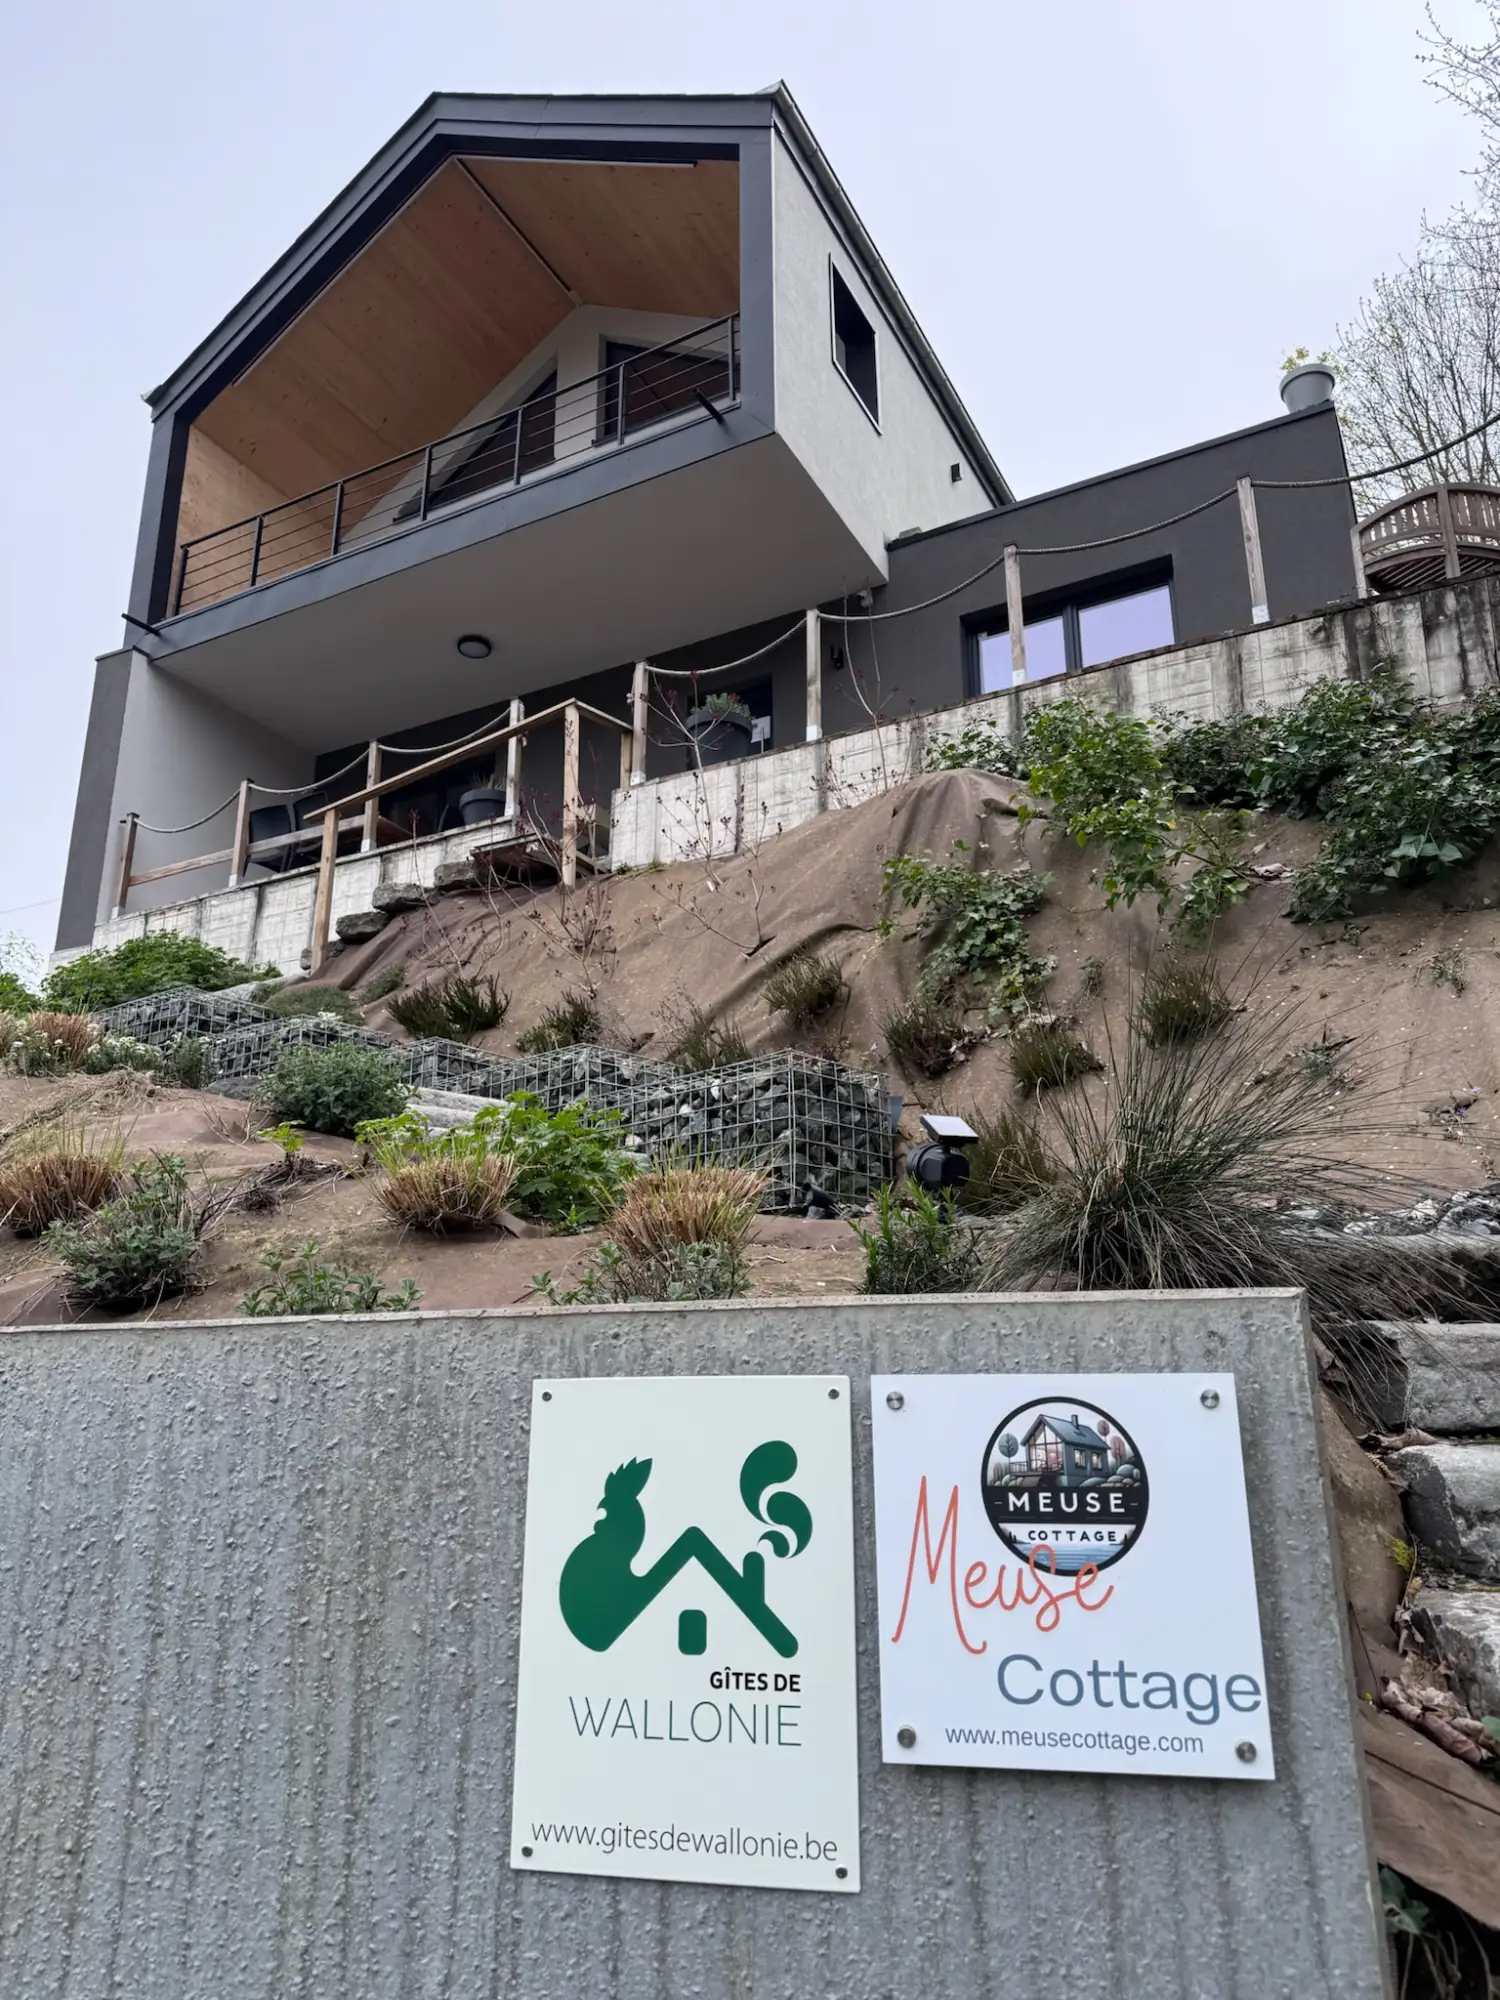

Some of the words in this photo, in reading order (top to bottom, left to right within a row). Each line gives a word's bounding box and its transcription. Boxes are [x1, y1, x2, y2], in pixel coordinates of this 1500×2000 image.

[1008, 1491, 1126, 1514] MEUSE
[1027, 1529, 1117, 1543] COTTAGE
[891, 1475, 1114, 1655] Meuse
[709, 1666, 768, 1691] GÎTES
[773, 1673, 802, 1693] DE
[997, 1653, 1262, 1726] Cottage
[569, 1696, 802, 1747] WALLONIE
[945, 1727, 1204, 1756] www.meusecottage.com
[531, 1822, 838, 1862] www.gitesdewallonie.be
